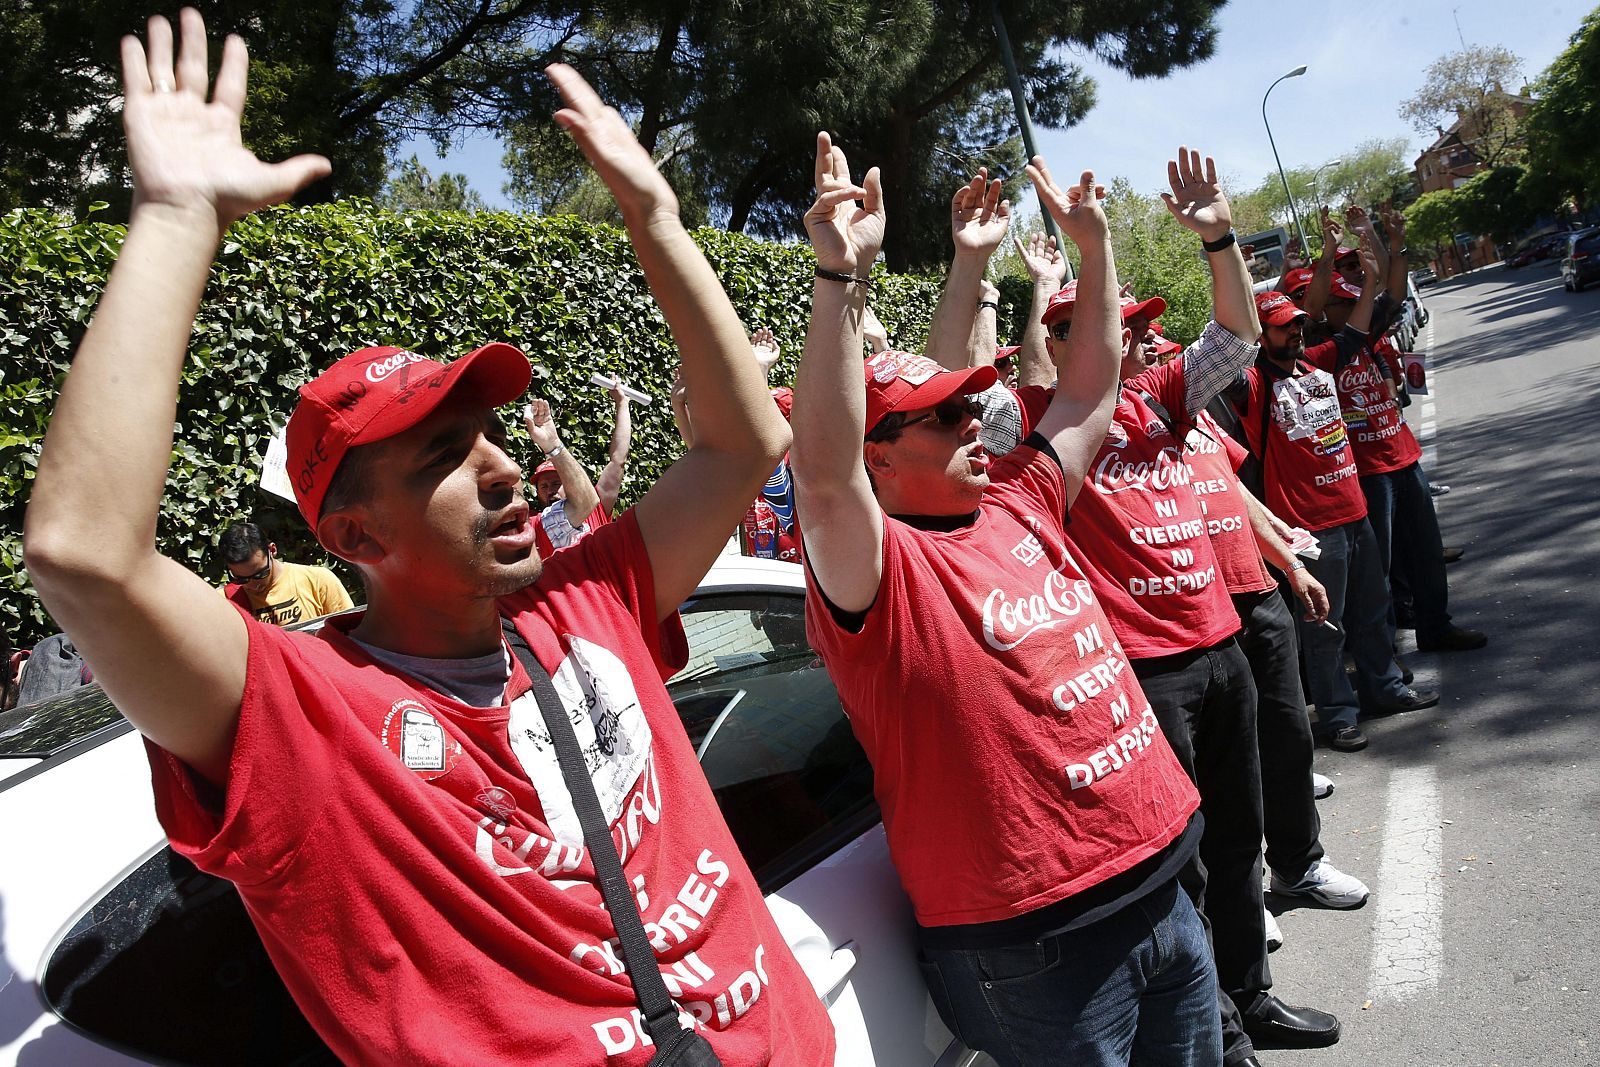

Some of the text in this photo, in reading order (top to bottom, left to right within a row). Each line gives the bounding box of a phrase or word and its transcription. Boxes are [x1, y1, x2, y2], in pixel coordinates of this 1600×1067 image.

[1154, 498, 1180, 519] NI
[1206, 515, 1243, 536] DOS
[1170, 548, 1195, 568] NI
[1073, 622, 1105, 659] NI
